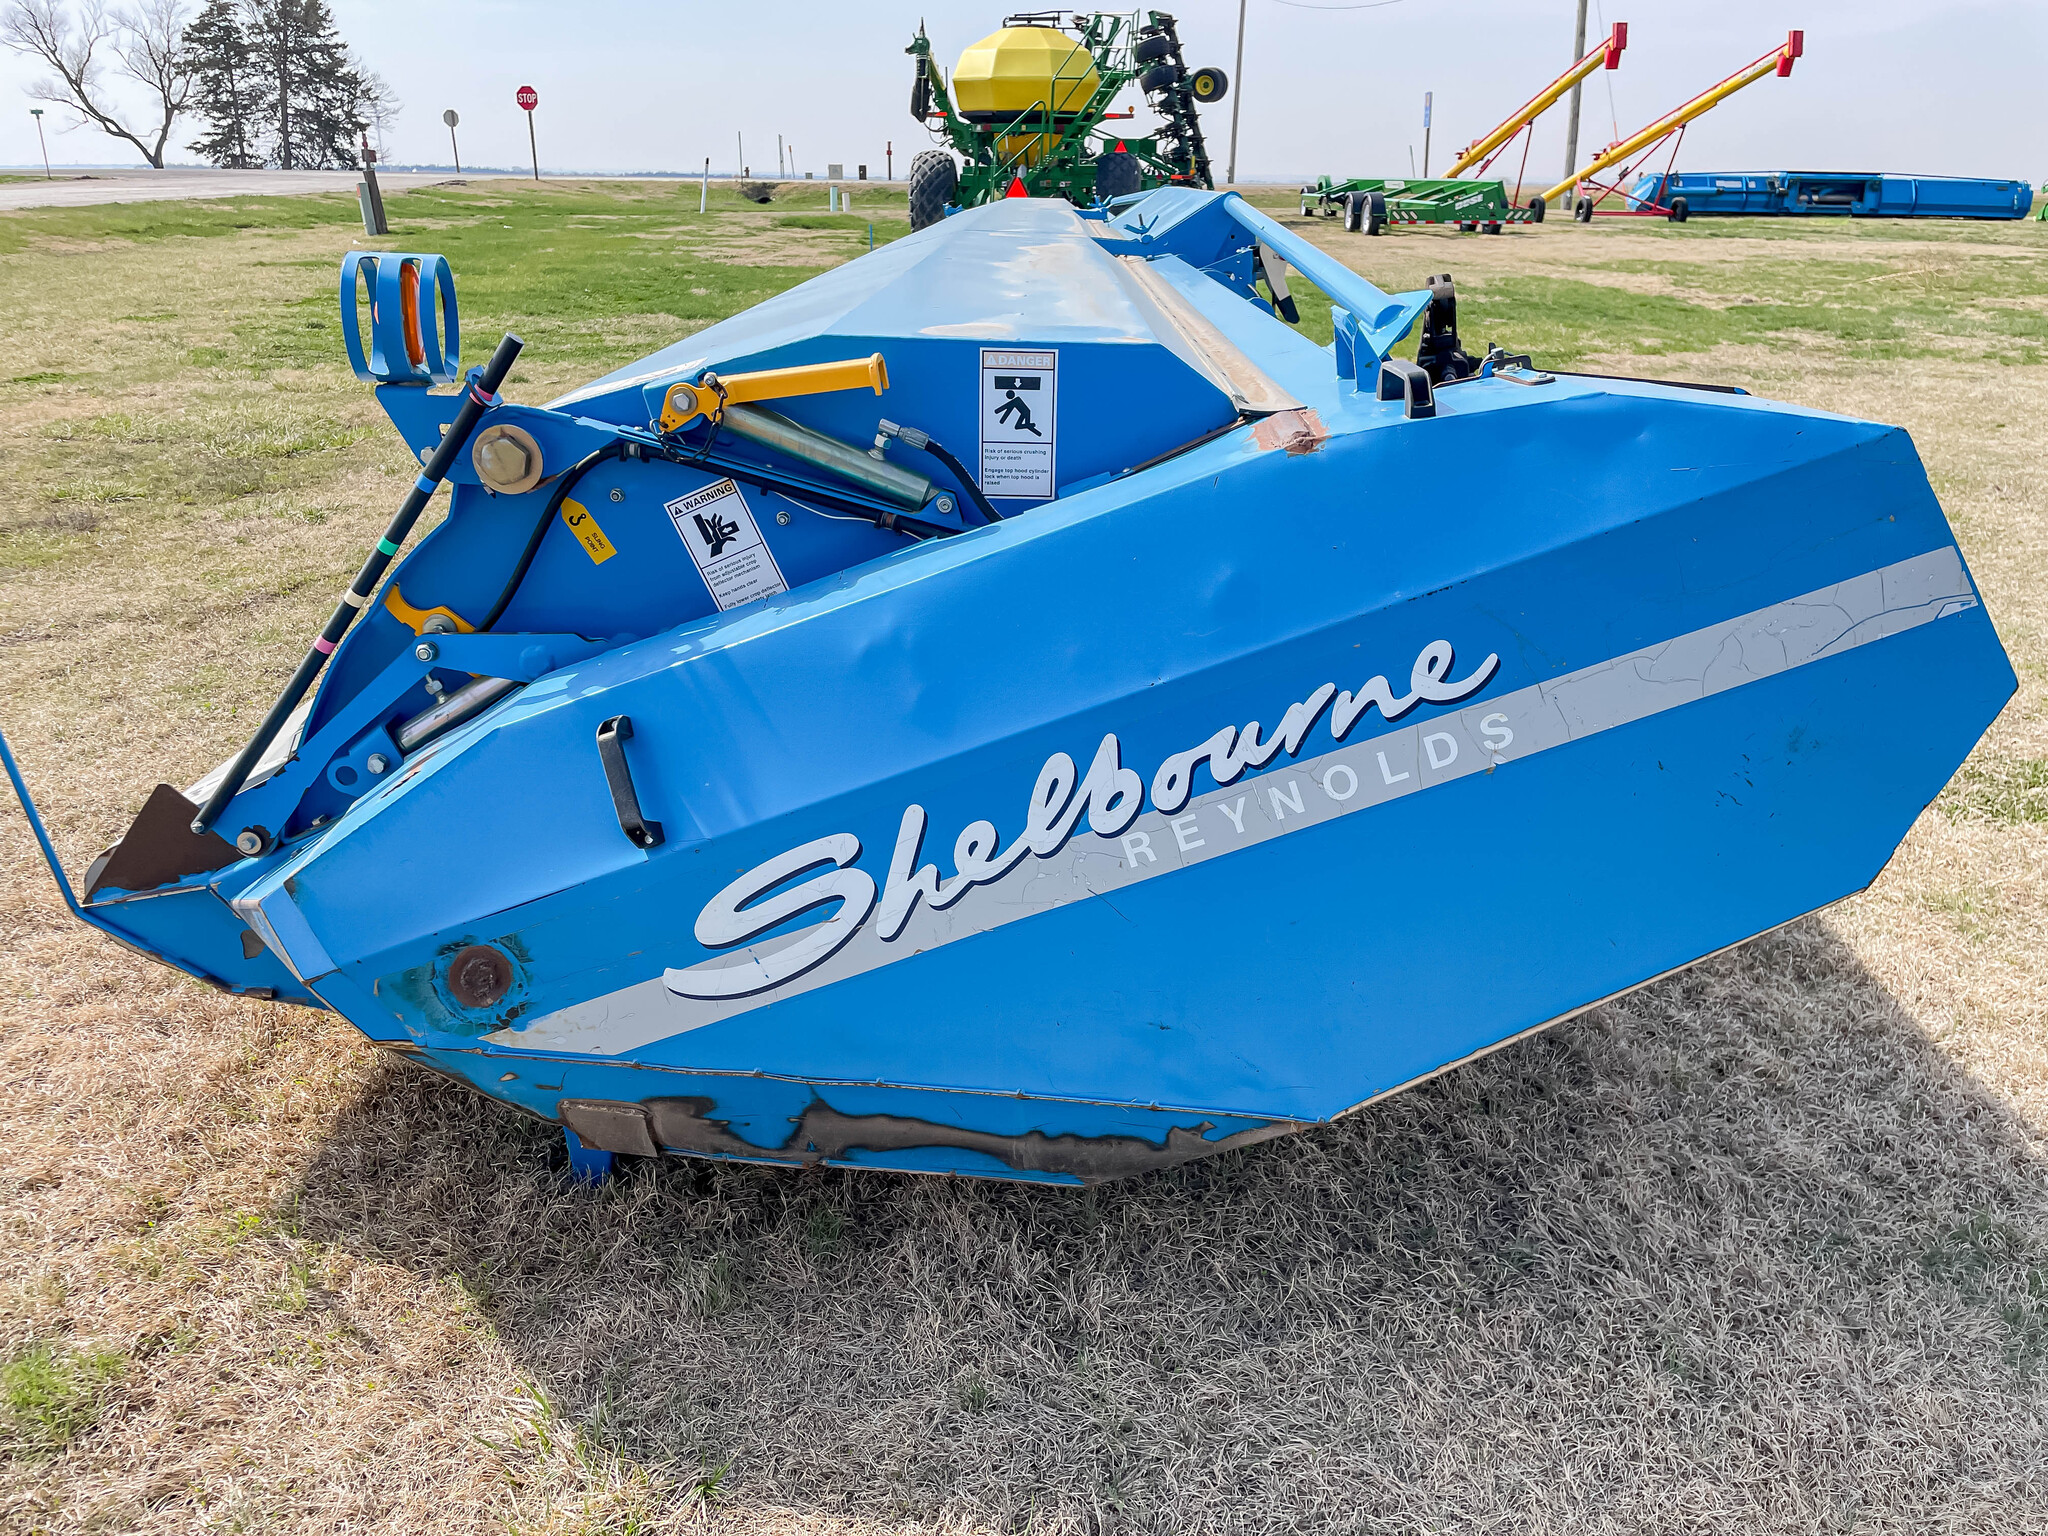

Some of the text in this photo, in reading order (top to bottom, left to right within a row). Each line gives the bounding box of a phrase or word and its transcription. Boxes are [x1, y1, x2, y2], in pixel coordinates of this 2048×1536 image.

[518, 93, 537, 104] STOP
[998, 355, 1051, 366] DANGER
[683, 484, 732, 510] WARNING
[585, 536, 599, 552] POINT
[592, 532, 606, 549] SLING
[707, 568, 718, 576] Risk
[724, 559, 741, 569] serious
[742, 553, 756, 561] injury
[722, 564, 745, 577] adjustable
[746, 559, 757, 567] crop
[713, 564, 760, 587] deflector mechanism
[731, 584, 746, 593] hands
[746, 579, 758, 587] clear
[736, 596, 749, 604] lower
[761, 582, 781, 593] deflector
[1120, 712, 1515, 869] REYNOLDS
[663, 638, 1501, 1001] Shelbourne
